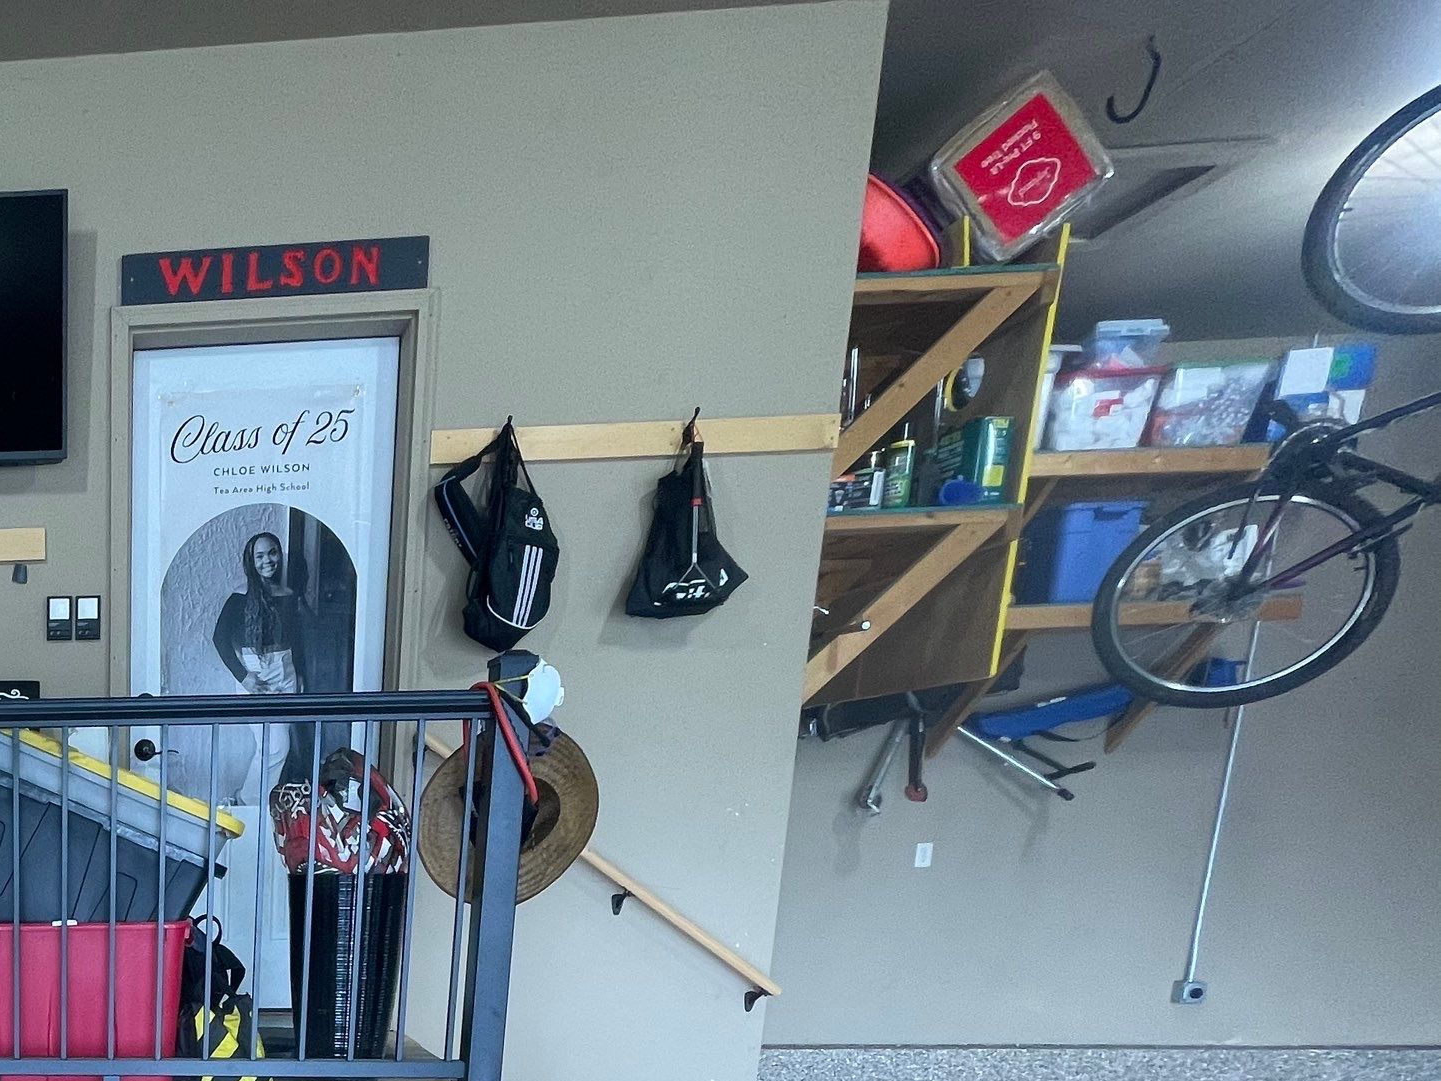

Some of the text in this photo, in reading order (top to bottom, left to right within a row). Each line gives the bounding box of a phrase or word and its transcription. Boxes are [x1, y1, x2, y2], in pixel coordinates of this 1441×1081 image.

[159, 245, 382, 297] WILSON
[170, 408, 356, 464] Class of 25
[213, 463, 310, 477] CHLOE WILSON
[214, 481, 310, 495] Tea Area High School
